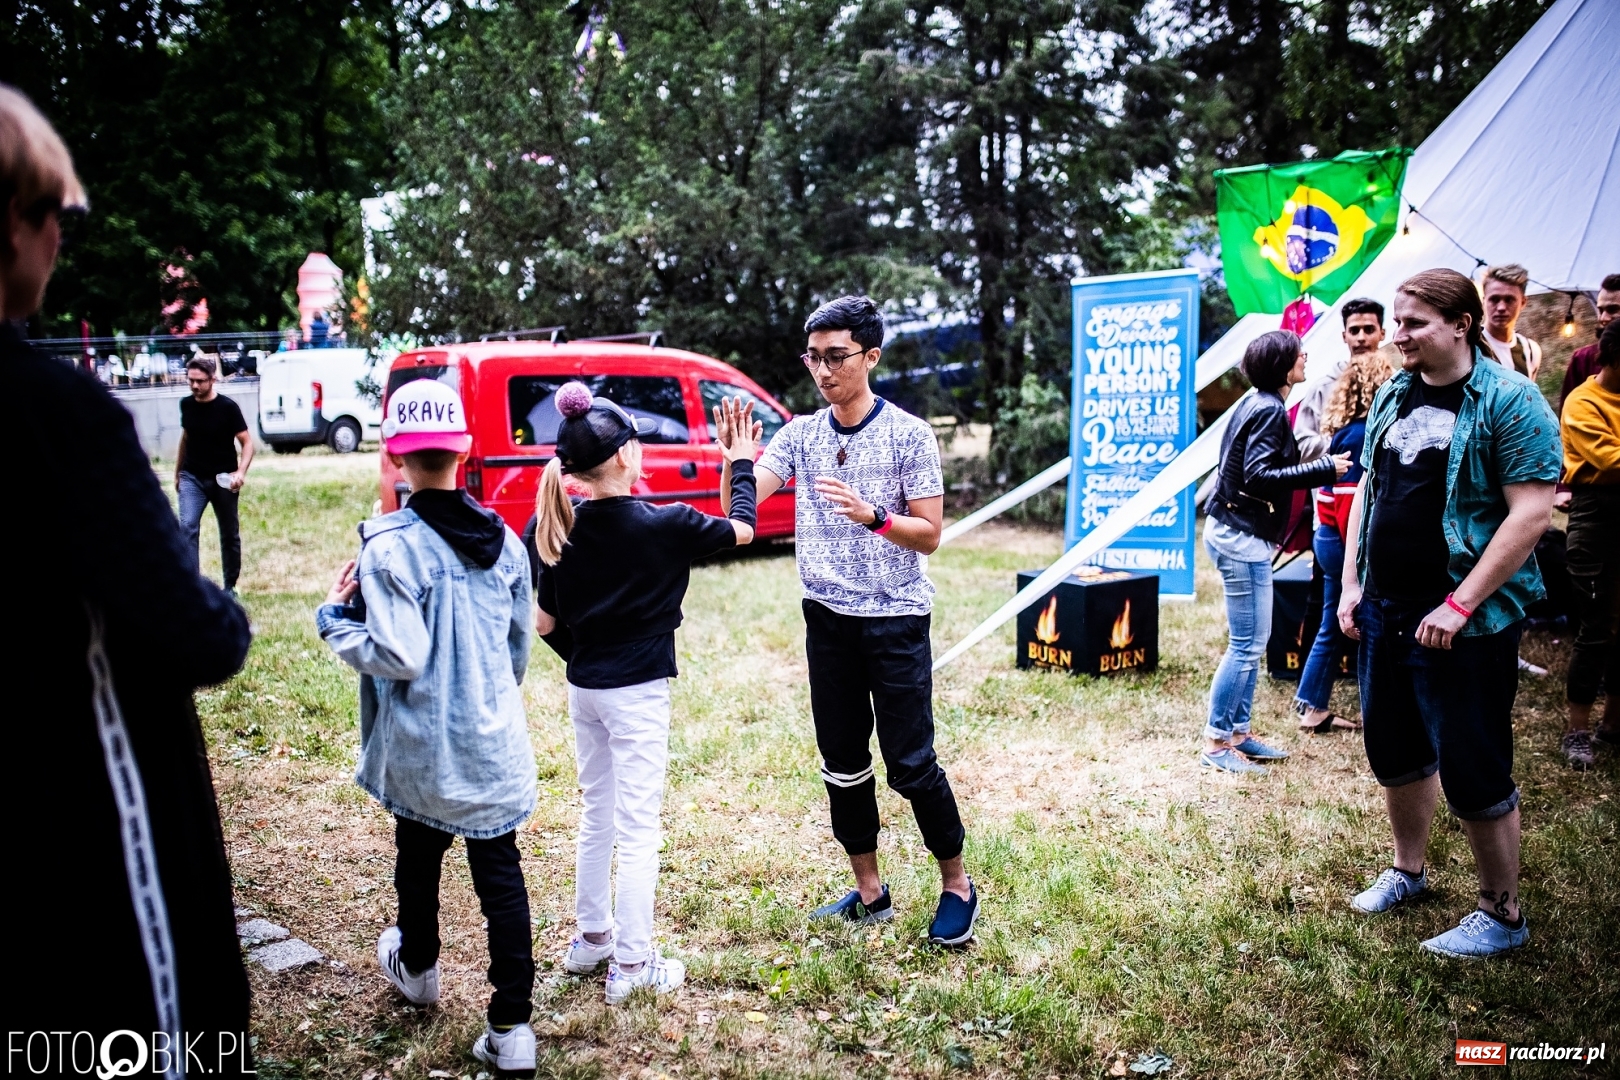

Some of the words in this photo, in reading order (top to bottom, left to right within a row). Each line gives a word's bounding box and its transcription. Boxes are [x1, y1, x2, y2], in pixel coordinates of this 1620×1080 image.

[1097, 323, 1178, 348] Develop
[1086, 344, 1181, 374] YOUNG
[1084, 371, 1181, 394] PERSON?
[397, 400, 455, 424] BRAVE
[1083, 397, 1152, 418] DRIVES
[1155, 396, 1180, 415] US
[1115, 425, 1131, 436] TO
[1132, 423, 1179, 435] ACHIEVE
[1130, 415, 1145, 425] WE
[1082, 416, 1179, 467] Peace
[1028, 641, 1072, 667] BURN
[1100, 648, 1145, 672] BURN
